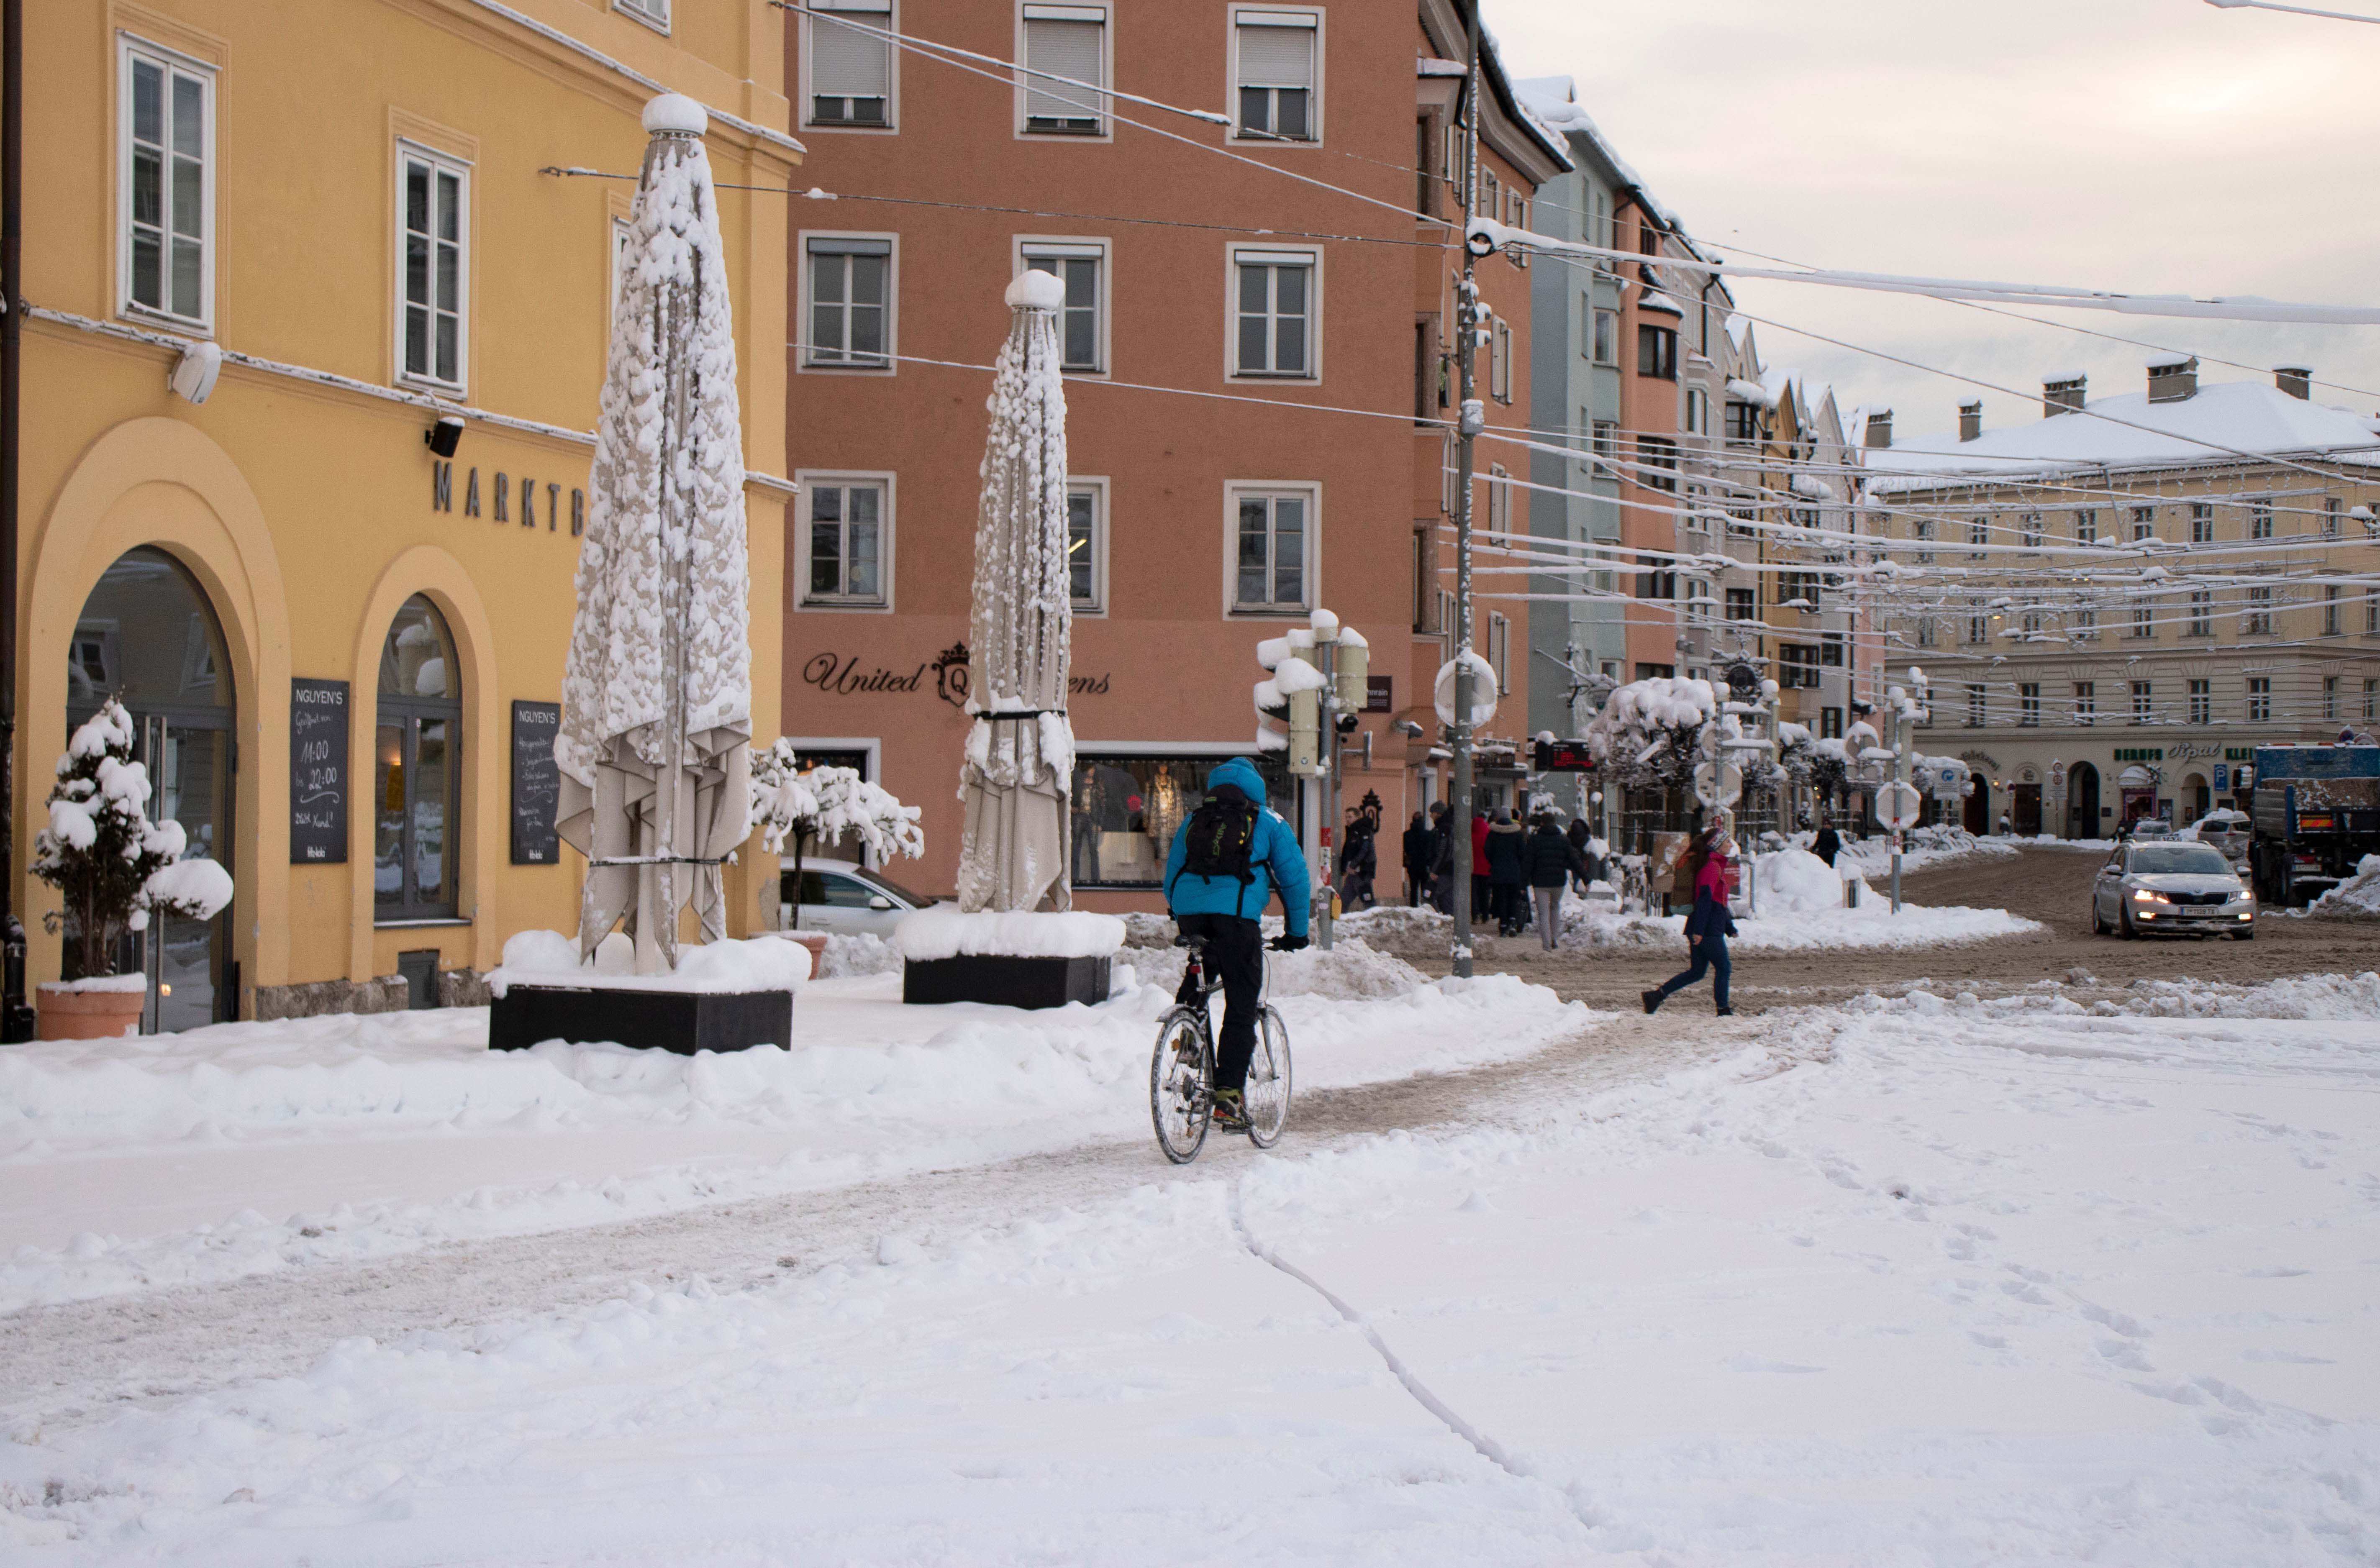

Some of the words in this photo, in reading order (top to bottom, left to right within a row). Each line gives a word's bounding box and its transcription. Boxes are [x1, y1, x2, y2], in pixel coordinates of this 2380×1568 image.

[433, 460, 585, 536] MARKTB
[803, 652, 926, 694] United
[951, 669, 967, 695] Q
[1068, 673, 1110, 694] ens
[296, 689, 343, 705] NGUYEN'S
[519, 710, 556, 725] NGUYEN'S
[2225, 748, 2254, 761] KLEI
[308, 767, 337, 791] 22:00
